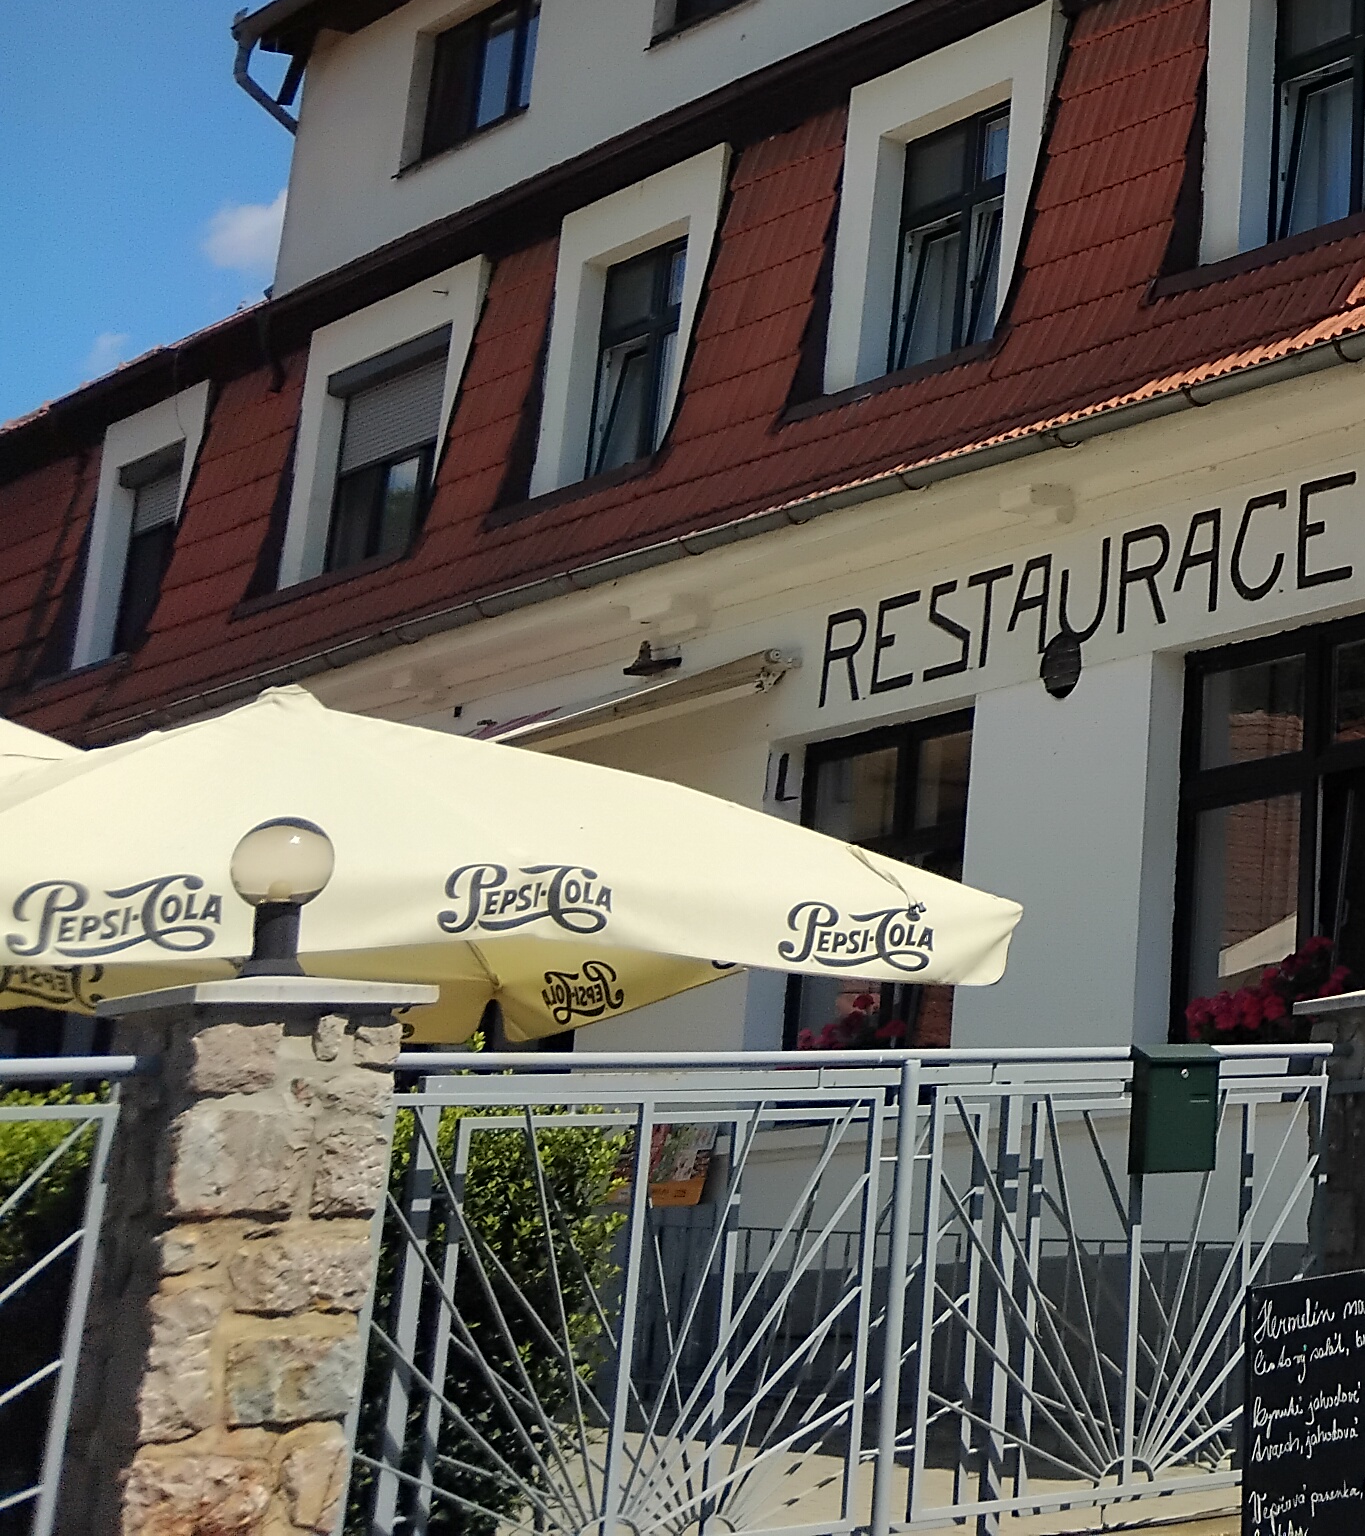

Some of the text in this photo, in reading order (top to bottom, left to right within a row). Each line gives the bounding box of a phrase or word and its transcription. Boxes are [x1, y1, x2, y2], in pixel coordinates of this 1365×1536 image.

[817, 470, 1357, 708] RESTAURACE
[5, 873, 223, 957] PEPSI-COLA
[437, 863, 613, 934] PEPSI-COLA
[777, 901, 934, 972] PEPSI-COLA
[1253, 1297, 1336, 1344] Hermelín
